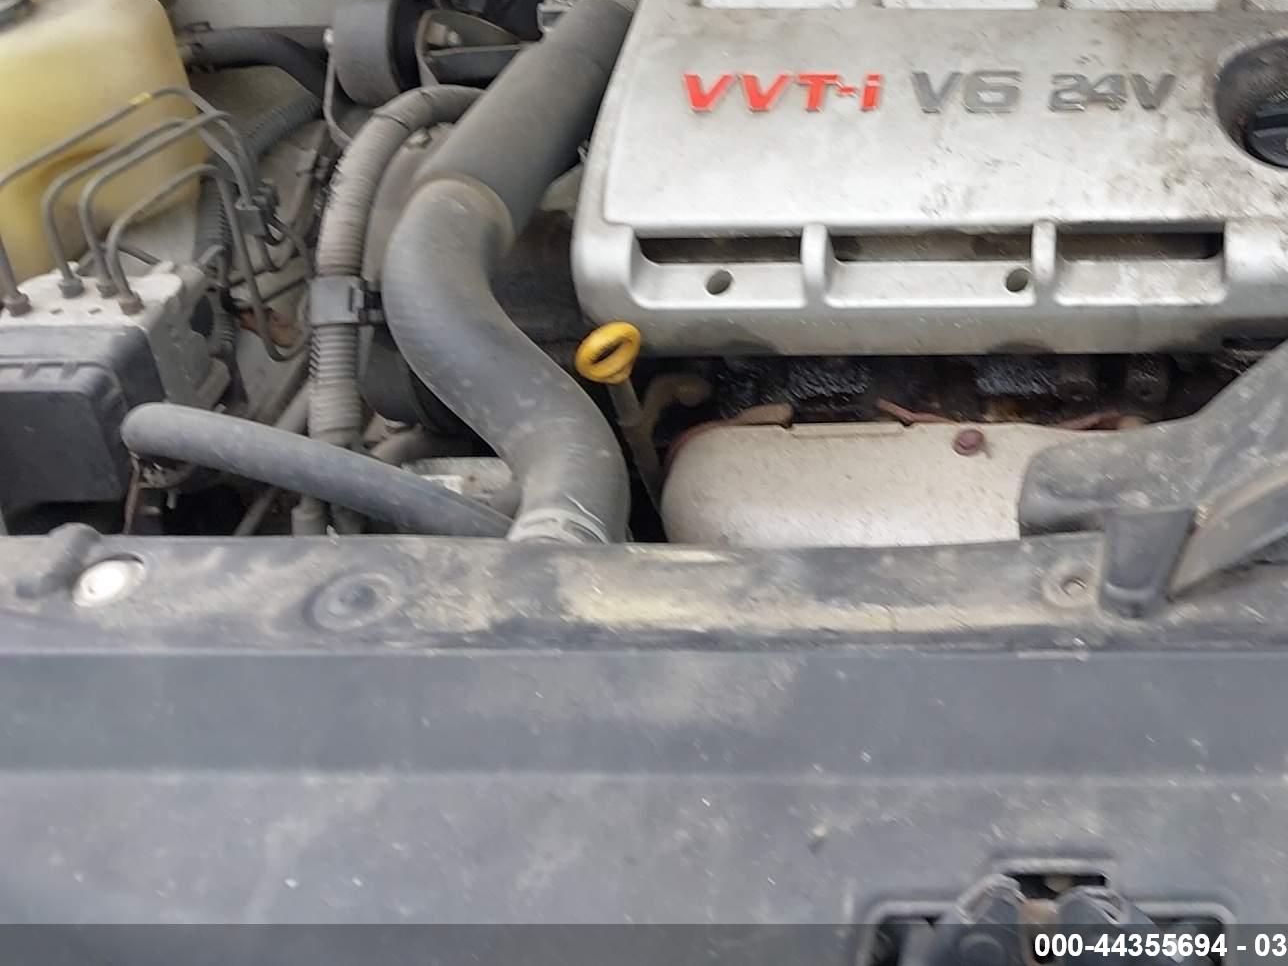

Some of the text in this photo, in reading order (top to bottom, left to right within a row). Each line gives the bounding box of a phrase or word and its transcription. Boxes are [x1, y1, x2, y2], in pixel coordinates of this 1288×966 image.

[683, 71, 1176, 113] VVT-i V6 24V
